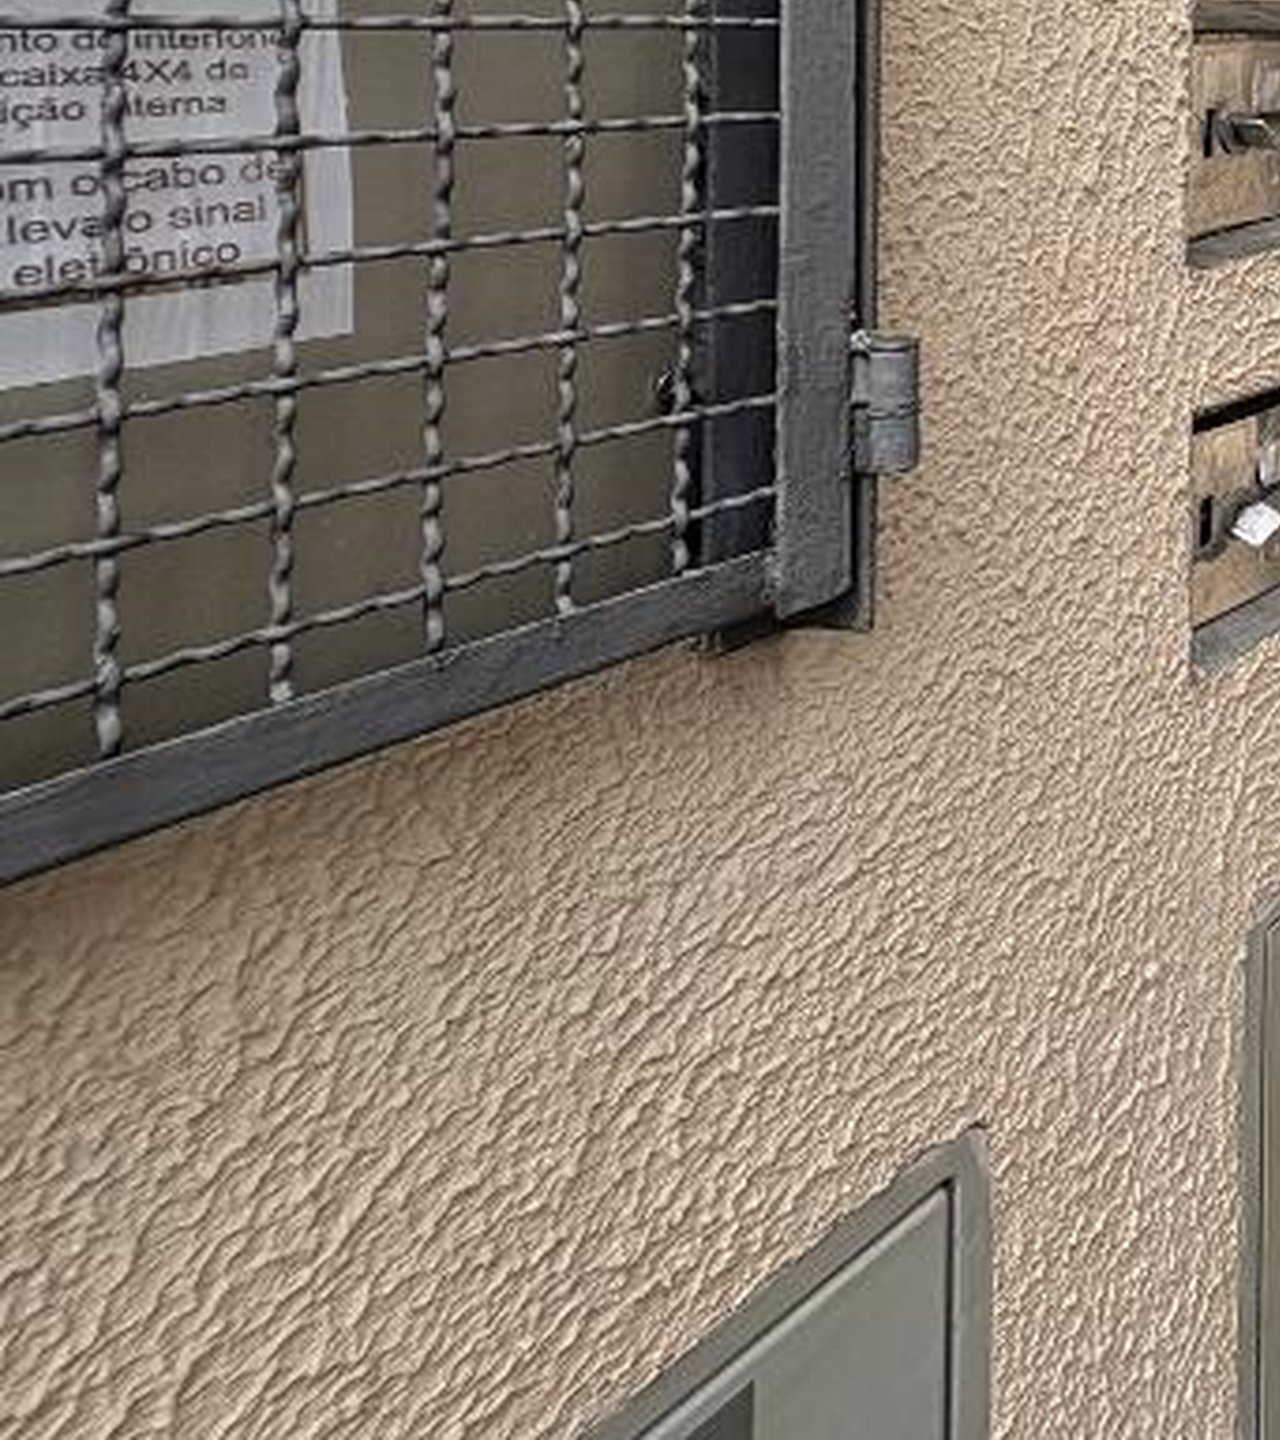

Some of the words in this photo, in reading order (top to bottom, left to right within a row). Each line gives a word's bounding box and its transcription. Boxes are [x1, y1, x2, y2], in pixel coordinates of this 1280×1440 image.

[71, 174, 99, 197] o
[126, 210, 151, 234] o
[168, 193, 266, 230] sinal
